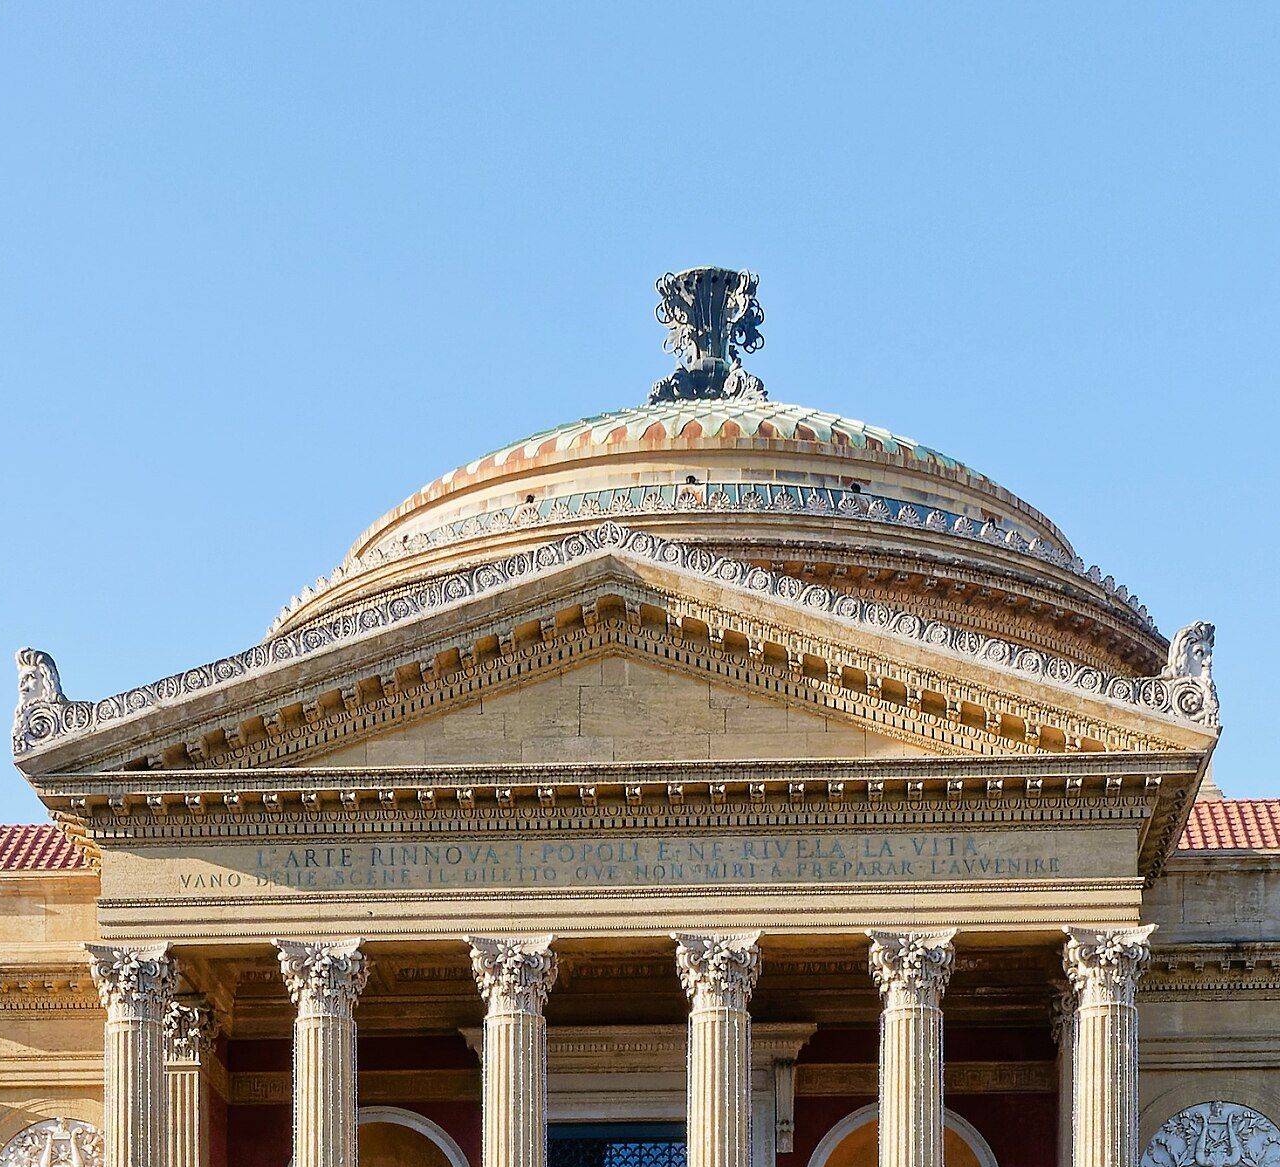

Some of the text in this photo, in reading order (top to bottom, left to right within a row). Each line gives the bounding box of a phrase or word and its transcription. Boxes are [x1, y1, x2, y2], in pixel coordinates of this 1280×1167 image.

[256, 848, 353, 868] L'ARTE
[371, 845, 499, 867] RINNOVA
[541, 841, 640, 864] POPOLI
[657, 840, 671, 861] E
[687, 840, 724, 861] NE
[741, 837, 846, 860] RIVELA
[863, 837, 895, 858] LA
[911, 836, 981, 857] VITA
[180, 874, 241, 888] VANO
[335, 869, 410, 885] SCENE
[427, 868, 449, 883] IL
[464, 866, 556, 882] DILETTO
[635, 863, 683, 881] NON
[704, 861, 756, 879] MIRI
[771, 861, 782, 878] A
[797, 859, 914, 878] PREPARAR
[931, 856, 1060, 876] L'AVVENIRE
